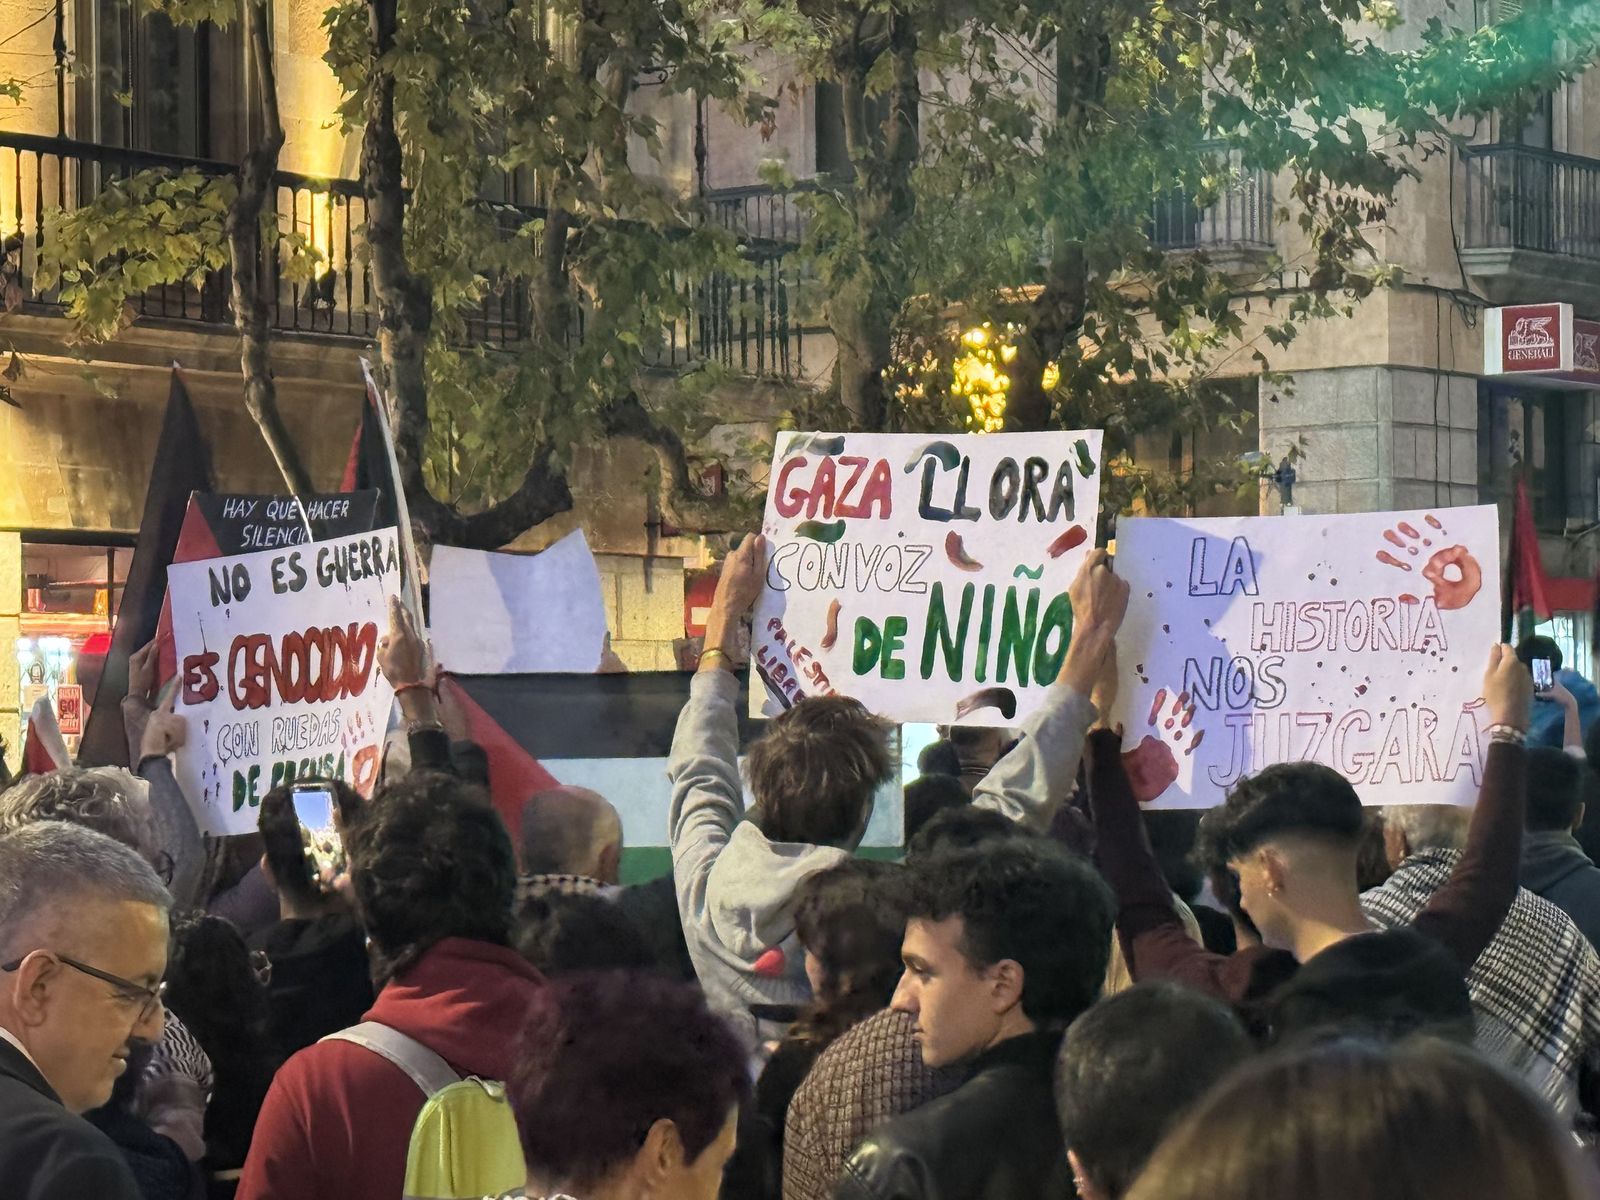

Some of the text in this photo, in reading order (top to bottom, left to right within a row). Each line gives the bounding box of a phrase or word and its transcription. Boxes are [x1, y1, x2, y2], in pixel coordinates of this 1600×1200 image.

[1508, 347, 1553, 360] GENERALI
[223, 498, 350, 520] HAY QUE HACER
[774, 456, 1075, 522] GAZA LLORA
[208, 536, 398, 608] NO ES GUERRA
[1188, 536, 1259, 596] LA
[853, 564, 1073, 687] DE NIÑO
[1250, 596, 1448, 653] HISTORIA
[183, 622, 378, 711] ES GENOCIDIO
[1182, 656, 1287, 710] NOS
[217, 708, 341, 761] CON RUEDAS
[1208, 697, 1486, 788] JUZGARÁ
[233, 764, 260, 812] DE
